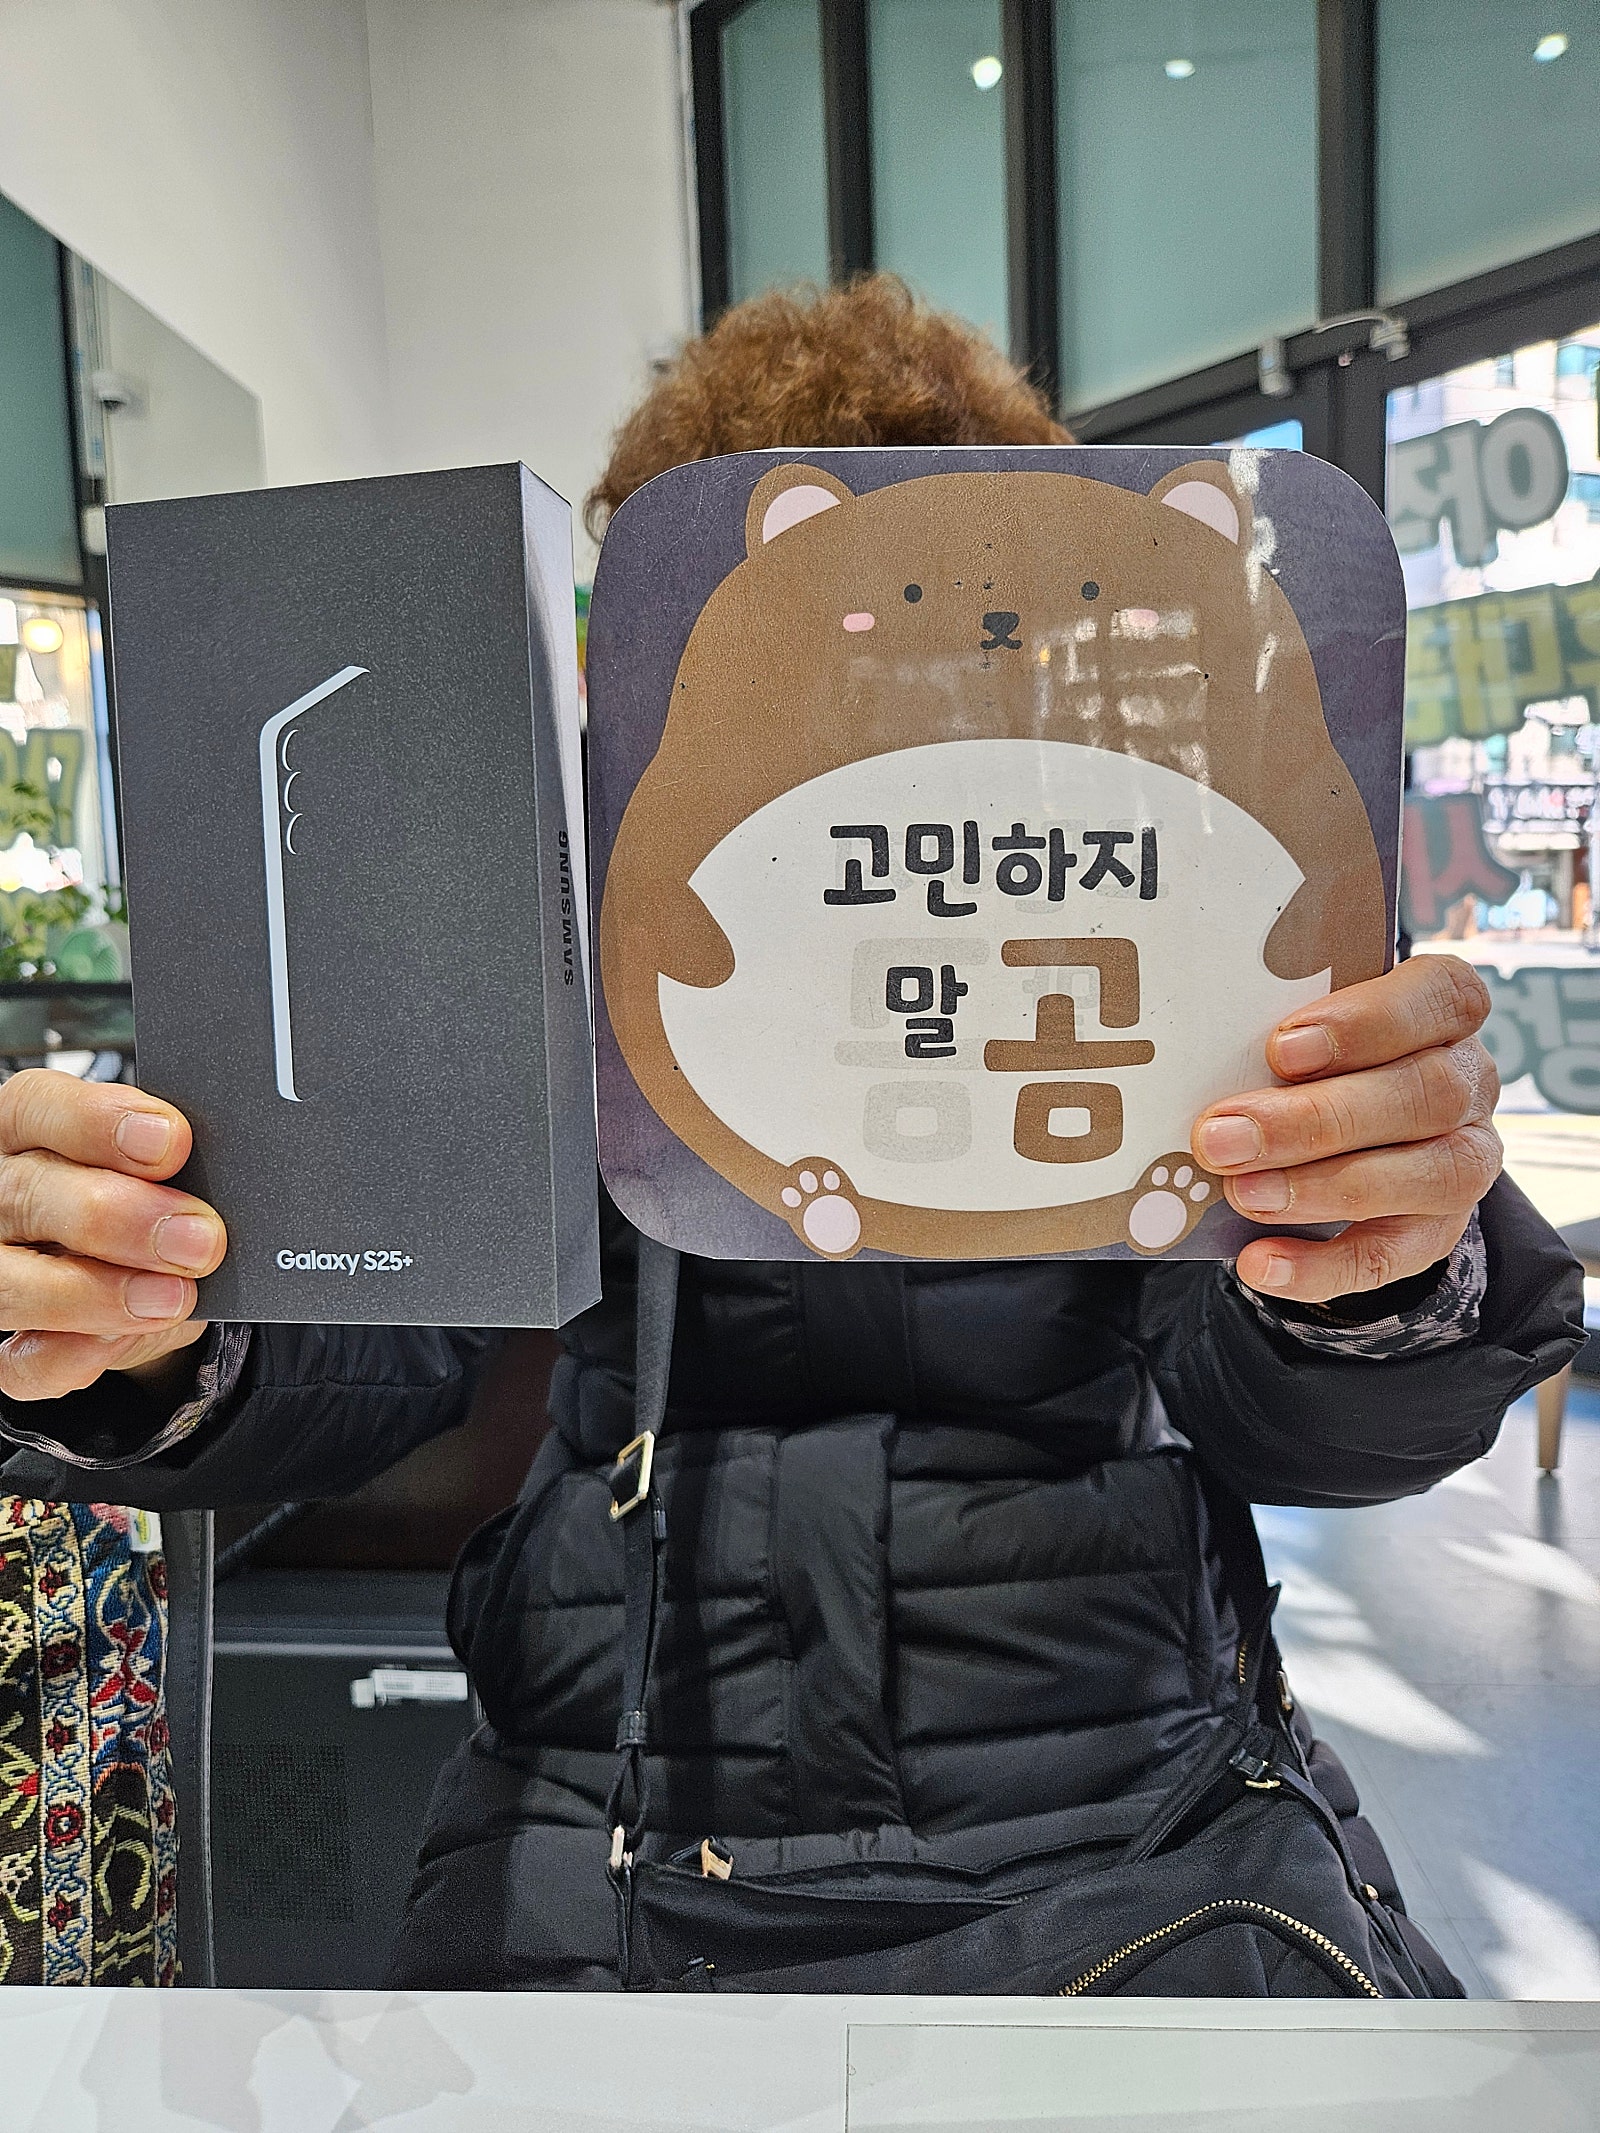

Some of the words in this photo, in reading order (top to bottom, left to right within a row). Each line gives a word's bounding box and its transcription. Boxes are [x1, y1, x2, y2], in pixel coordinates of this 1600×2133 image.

[558, 830, 574, 987] SAMSUNG
[823, 820, 1159, 918] 고민하지
[276, 1249, 360, 1276] Galaxy
[363, 1250, 414, 1271] S25+
